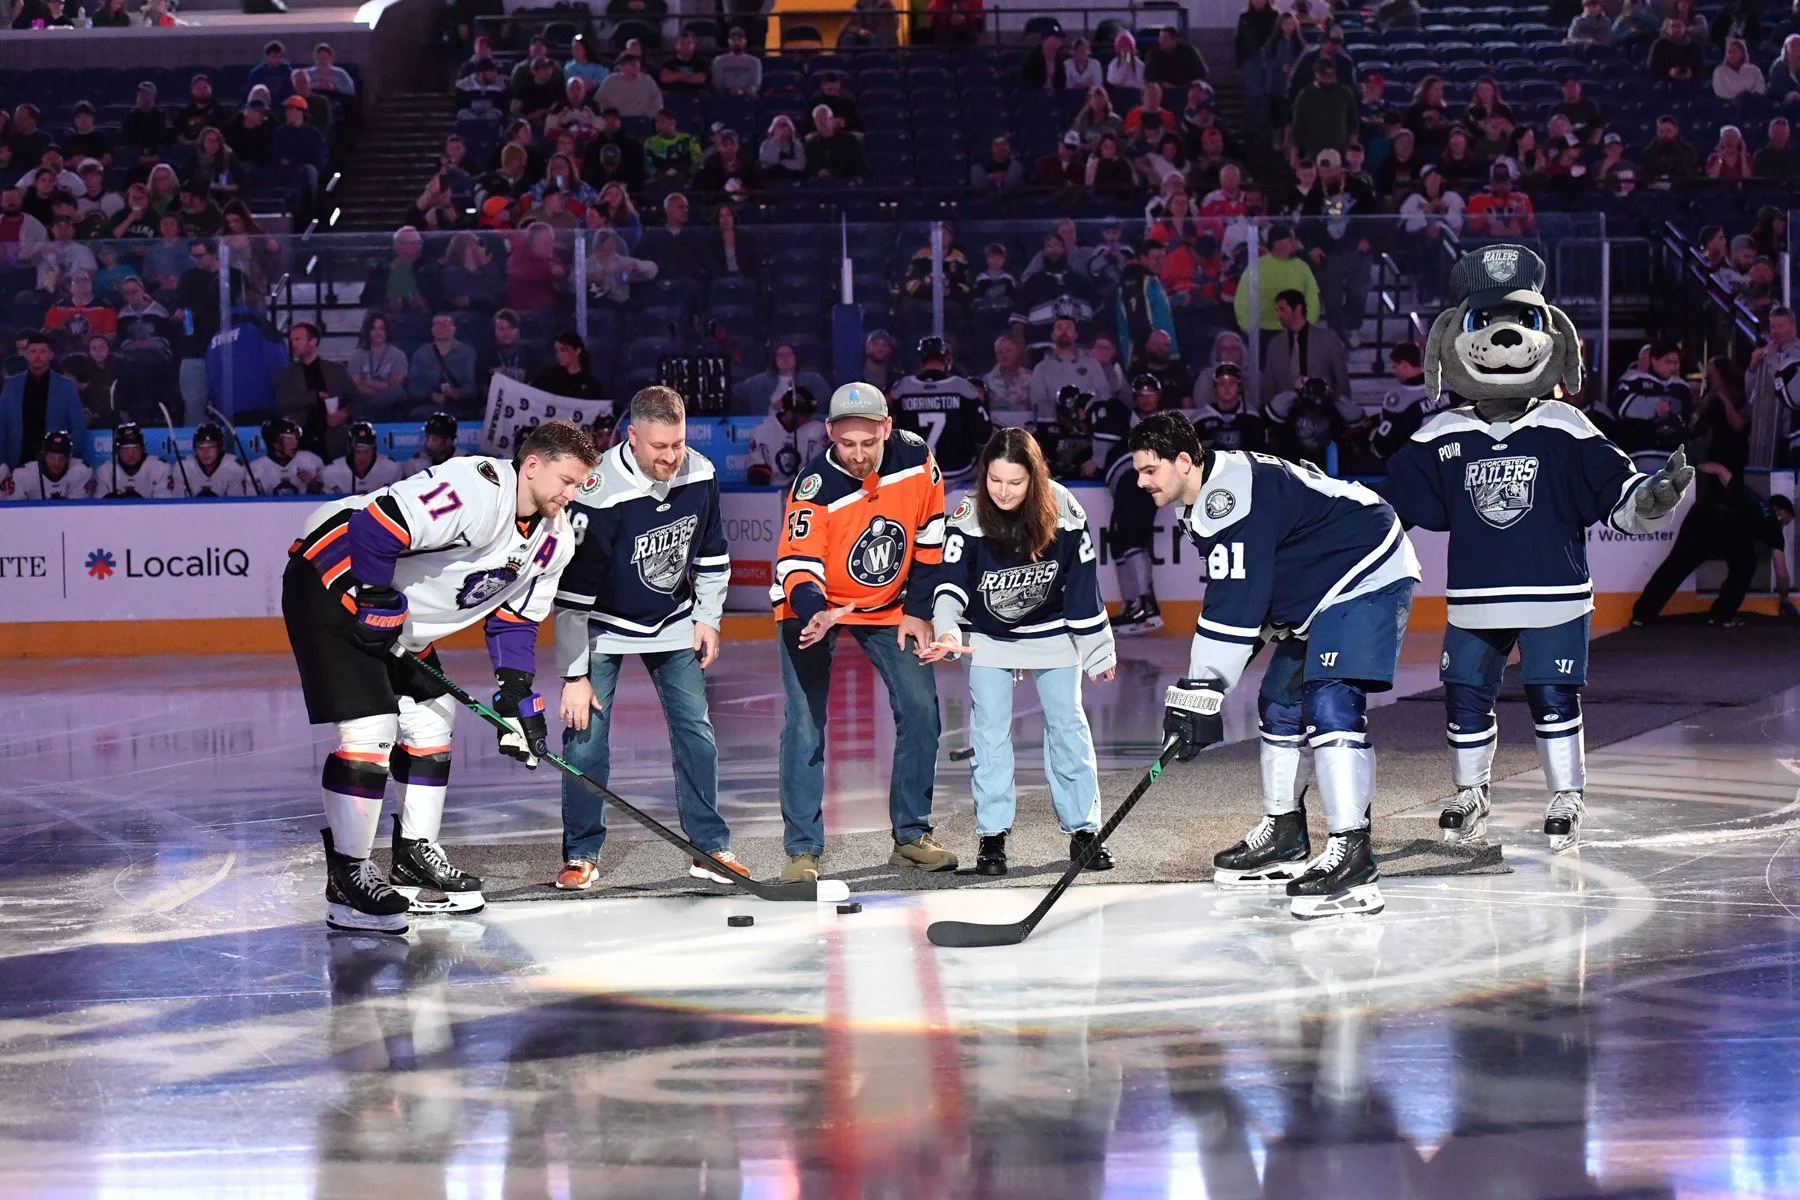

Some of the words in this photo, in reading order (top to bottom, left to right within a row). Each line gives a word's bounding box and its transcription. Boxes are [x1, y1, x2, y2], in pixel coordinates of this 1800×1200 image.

[1483, 250, 1519, 262] RAILERS
[918, 412, 946, 456] 7
[1467, 460, 1536, 488] RAILERS
[418, 482, 463, 521] 17
[635, 517, 698, 561] RAILERS
[788, 509, 813, 545] 55
[126, 548, 250, 577] LocaliQ
[533, 533, 558, 569] A
[867, 540, 892, 572] W
[982, 563, 1056, 591] RAILERS
[999, 564, 1044, 577] WORCESTER
[397, 864, 423, 883] CCM
